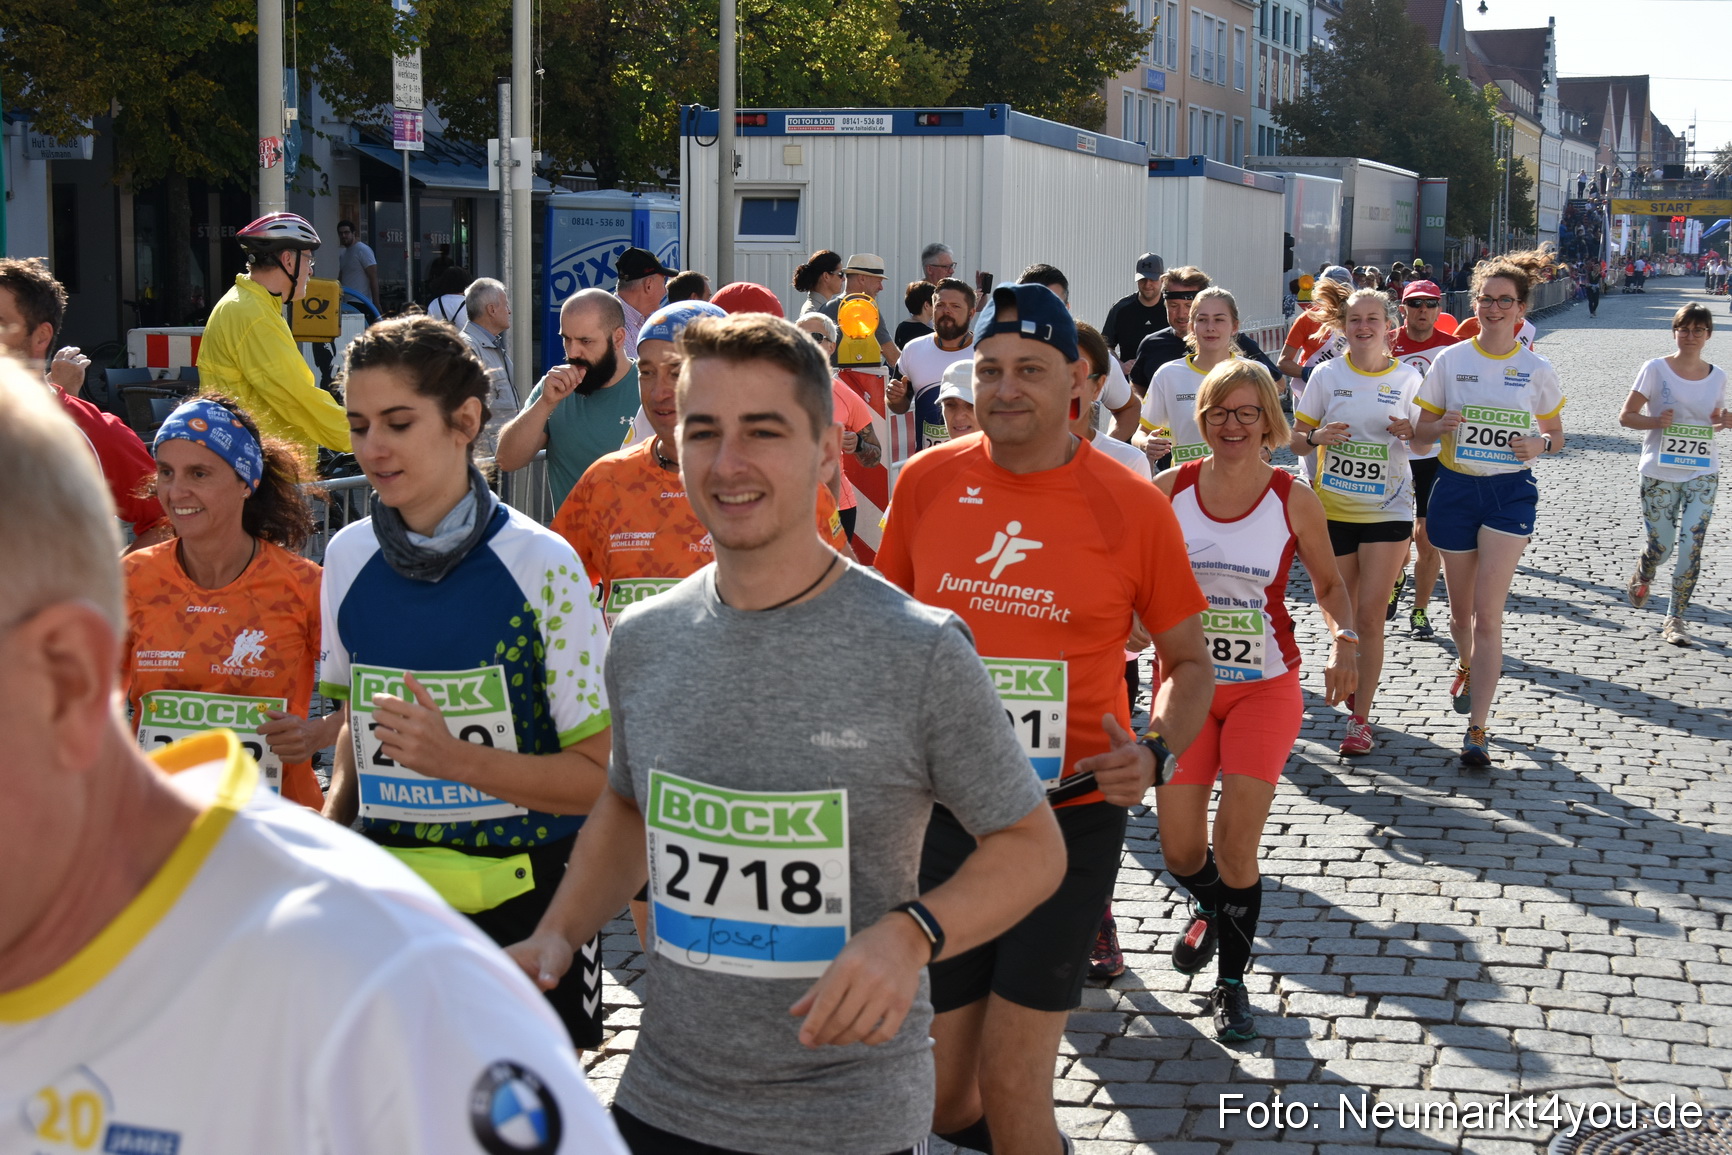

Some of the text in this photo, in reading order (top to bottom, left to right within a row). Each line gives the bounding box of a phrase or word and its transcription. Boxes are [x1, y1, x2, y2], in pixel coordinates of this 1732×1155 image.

[395, 58, 419, 69] Parkschein
[31, 137, 46, 148] Hut
[48, 137, 55, 148] &
[40, 150, 72, 158] Hülsmann
[1651, 203, 1692, 213] START
[571, 217, 594, 226] 08141
[600, 218, 613, 227] 536
[615, 218, 625, 227] 80
[197, 225, 236, 238] STREB
[430, 233, 451, 244] STREB
[1315, 349, 1335, 364] wir
[1505, 368, 1517, 376] 20
[1379, 385, 1391, 394] 20
[1466, 406, 1526, 426] BOCK
[212, 427, 233, 447] GIPFEL
[1667, 426, 1708, 438] BOCK
[1330, 440, 1384, 459] BOCK
[1666, 438, 1707, 455] 2276
[1462, 448, 1519, 462] ALEXANDRA
[1674, 457, 1697, 465] RUTH
[1329, 455, 1381, 480] 2039
[1329, 477, 1376, 493] CHRISTIN
[959, 496, 984, 504] erima
[611, 540, 650, 548] WOHLLEBEN
[1191, 561, 1271, 578] hysiotherapie Wild
[936, 572, 1055, 604] funrunners
[187, 605, 219, 613] CRAFT
[1206, 595, 1263, 609] chen Sie fit!
[969, 596, 1072, 624] neumarkt
[1205, 637, 1251, 664] 82
[360, 673, 494, 713] BOCK
[152, 695, 273, 729] BOCK
[496, 724, 506, 734] D
[811, 730, 868, 749] ellesse
[658, 782, 829, 842] BOCK
[665, 844, 823, 915] 2718
[686, 915, 779, 965] Josef
[35, 1084, 105, 1150] 20
